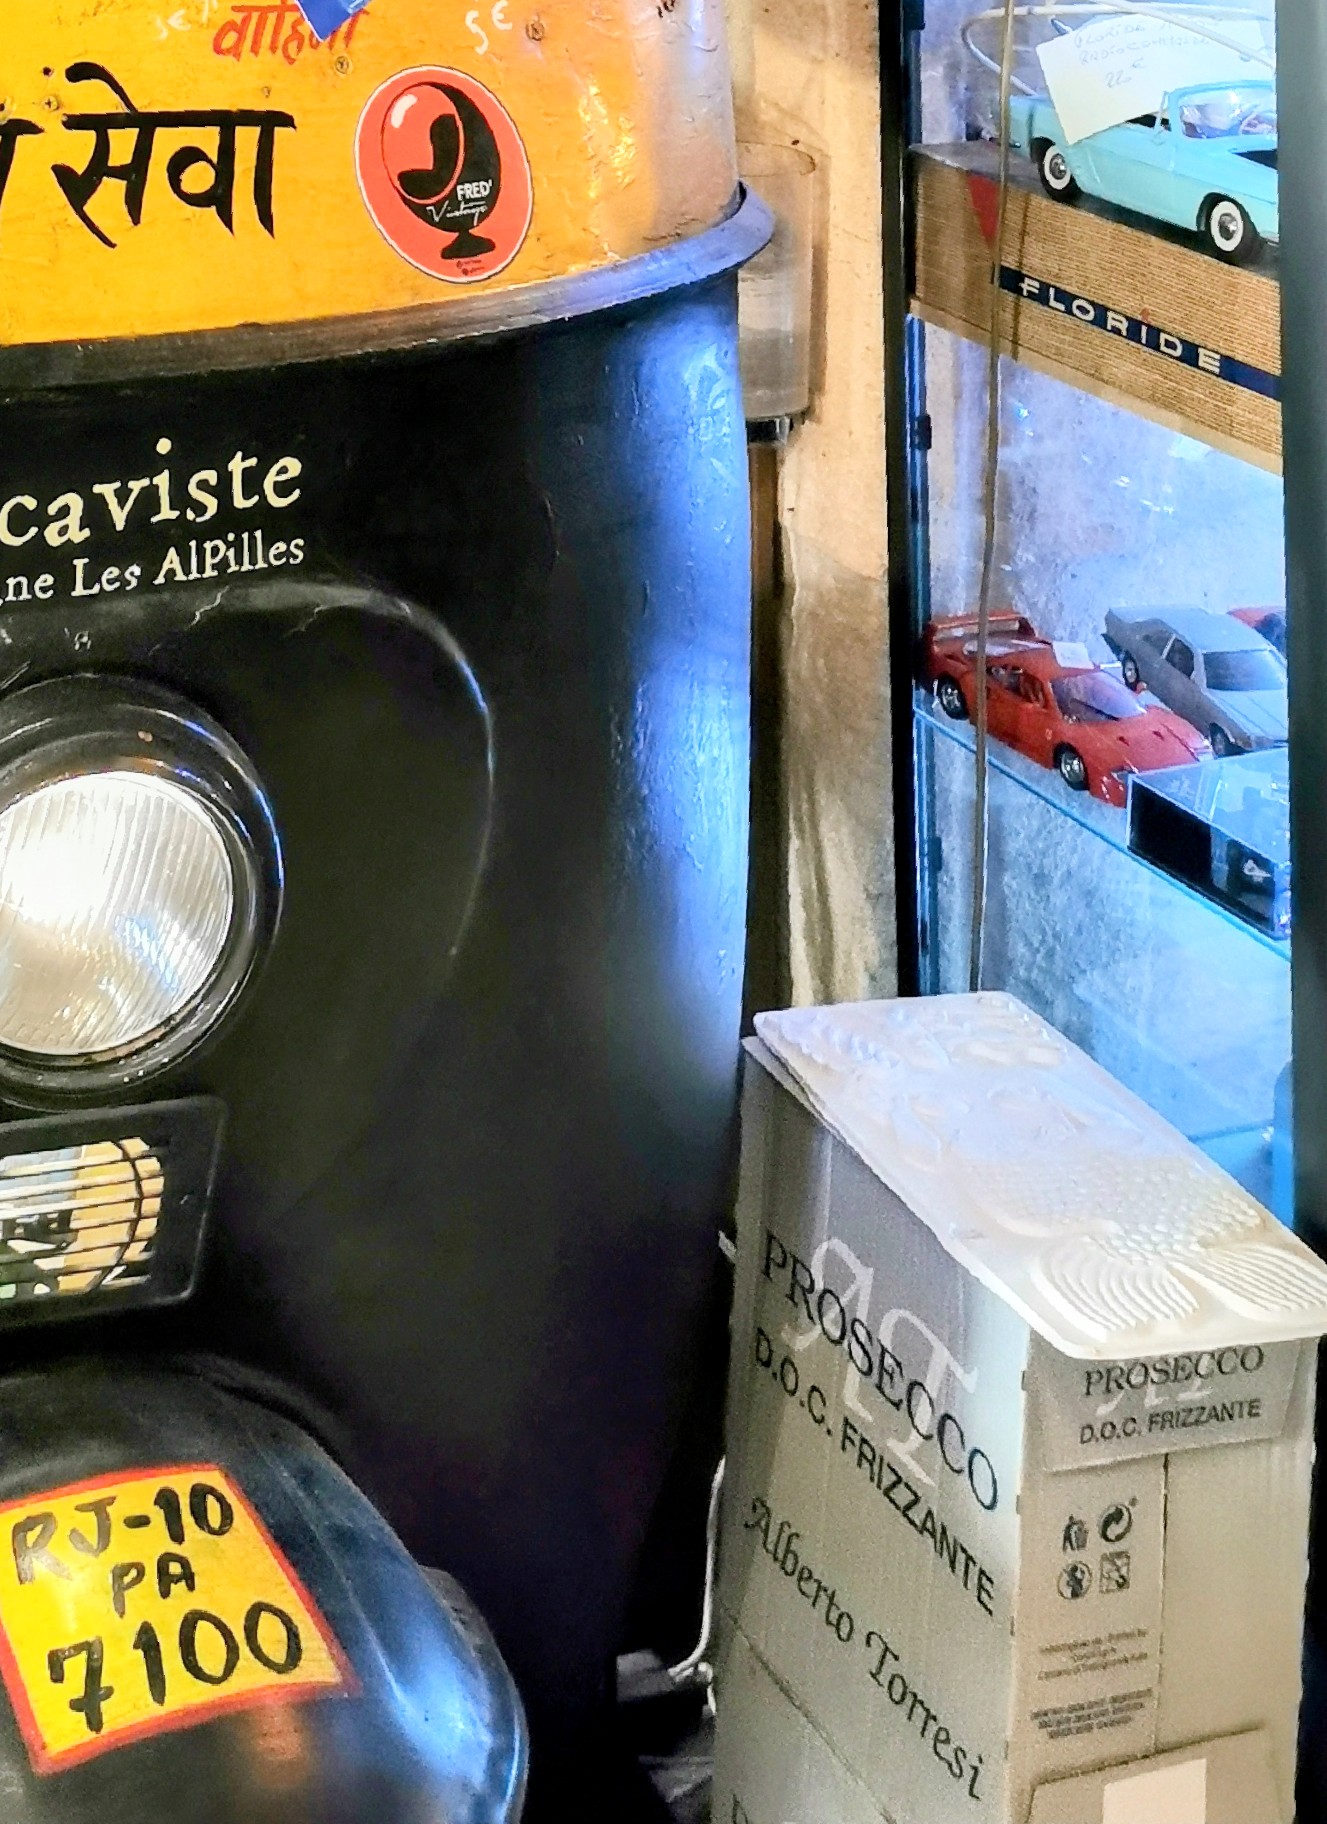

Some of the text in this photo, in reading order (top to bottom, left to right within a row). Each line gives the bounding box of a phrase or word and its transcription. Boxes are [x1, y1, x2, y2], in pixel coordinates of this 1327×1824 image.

[51, 61, 297, 249] सेवा
[425, 199, 489, 227] Vintage
[1017, 276, 1223, 375] FLORIDE
[71, 557, 142, 598] Les
[152, 529, 306, 586] AlPilles
[760, 1228, 998, 1511] PROSECCO
[1084, 1344, 1265, 1397] PROSECCO
[754, 1326, 994, 1617] D.O.C. FRIZZANTE
[1079, 1397, 1262, 1446] D.O.C. FRIZZANTE
[10, 1481, 234, 1586] RJ-10
[112, 1551, 197, 1618] PA
[47, 1600, 303, 1735] 7100
[743, 1495, 983, 1801] Alberto Torresi
